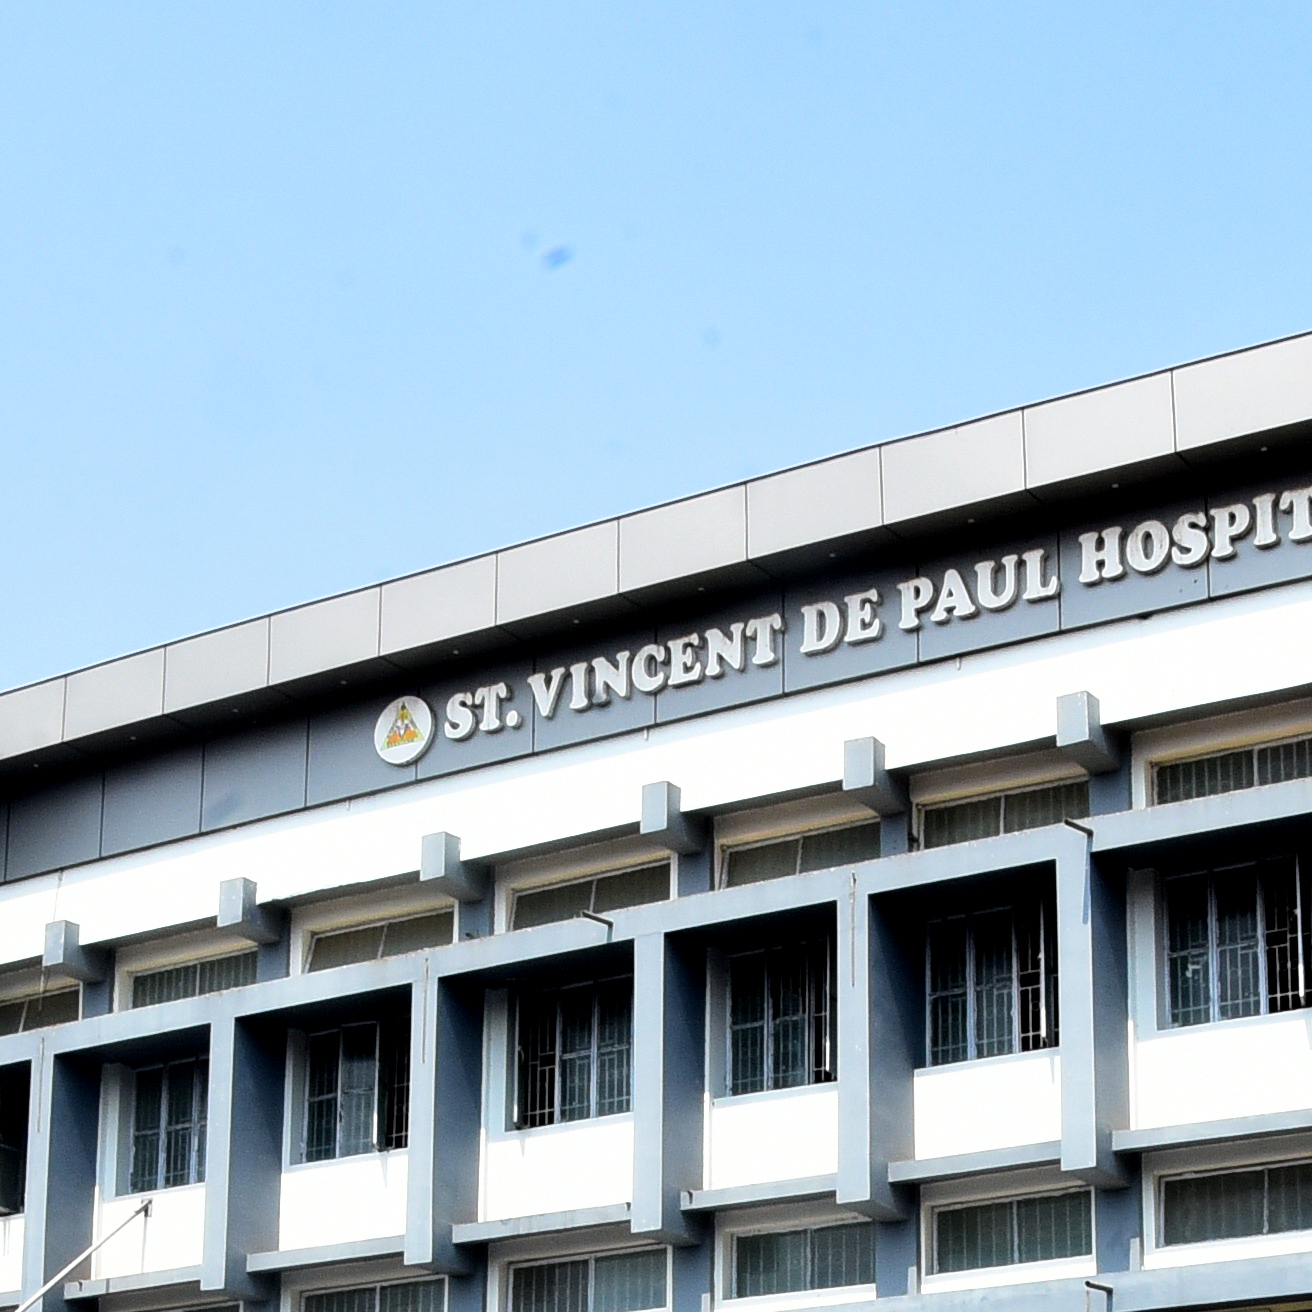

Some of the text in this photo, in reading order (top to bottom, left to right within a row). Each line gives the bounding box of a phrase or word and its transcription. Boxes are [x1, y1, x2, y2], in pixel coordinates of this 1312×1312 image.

[443, 683, 523, 741] ST.
[527, 614, 784, 719] VINCENT
[800, 591, 882, 656] DE
[896, 548, 1060, 632] PAUL
